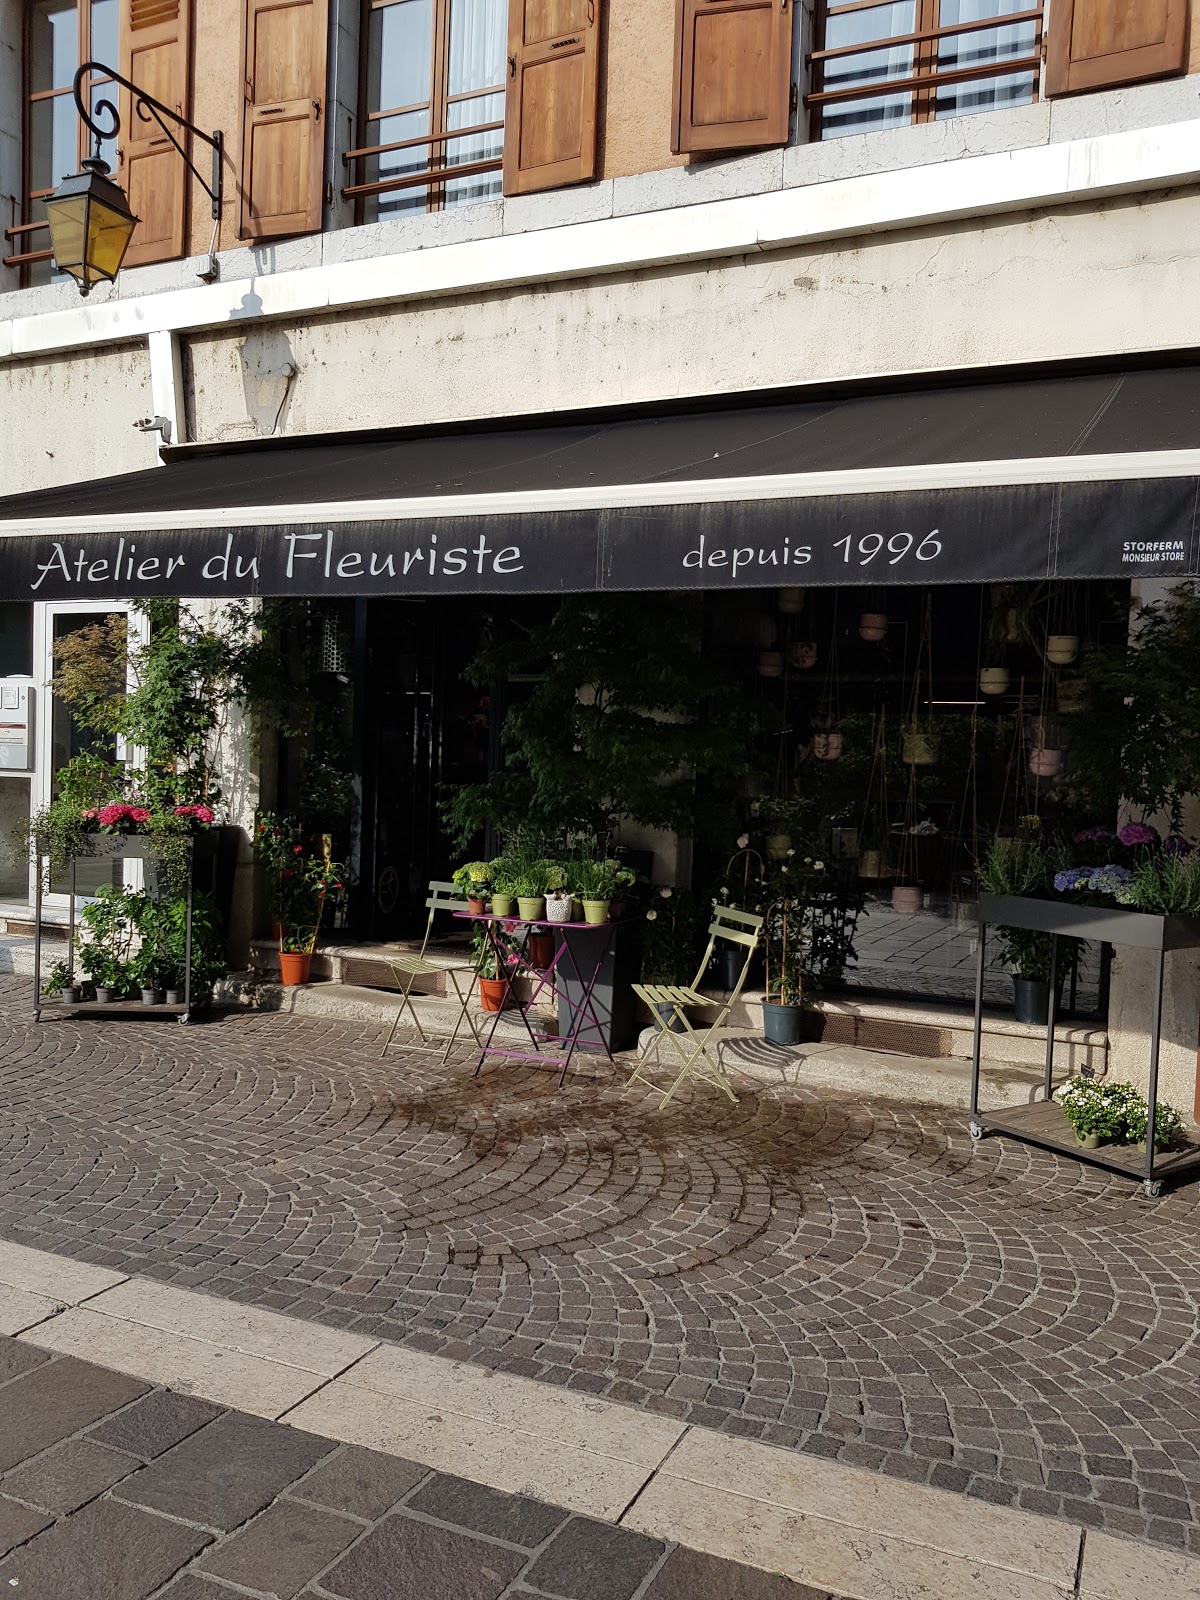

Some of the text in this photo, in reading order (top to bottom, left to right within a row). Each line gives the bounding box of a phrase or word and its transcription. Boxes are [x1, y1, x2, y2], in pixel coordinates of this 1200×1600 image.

[30, 529, 525, 590] Atelier du Fleuriste
[681, 528, 943, 578] depuis 1996
[1121, 551, 1185, 563] MONSIEUR STORE
[1122, 540, 1184, 551] STORFERM
